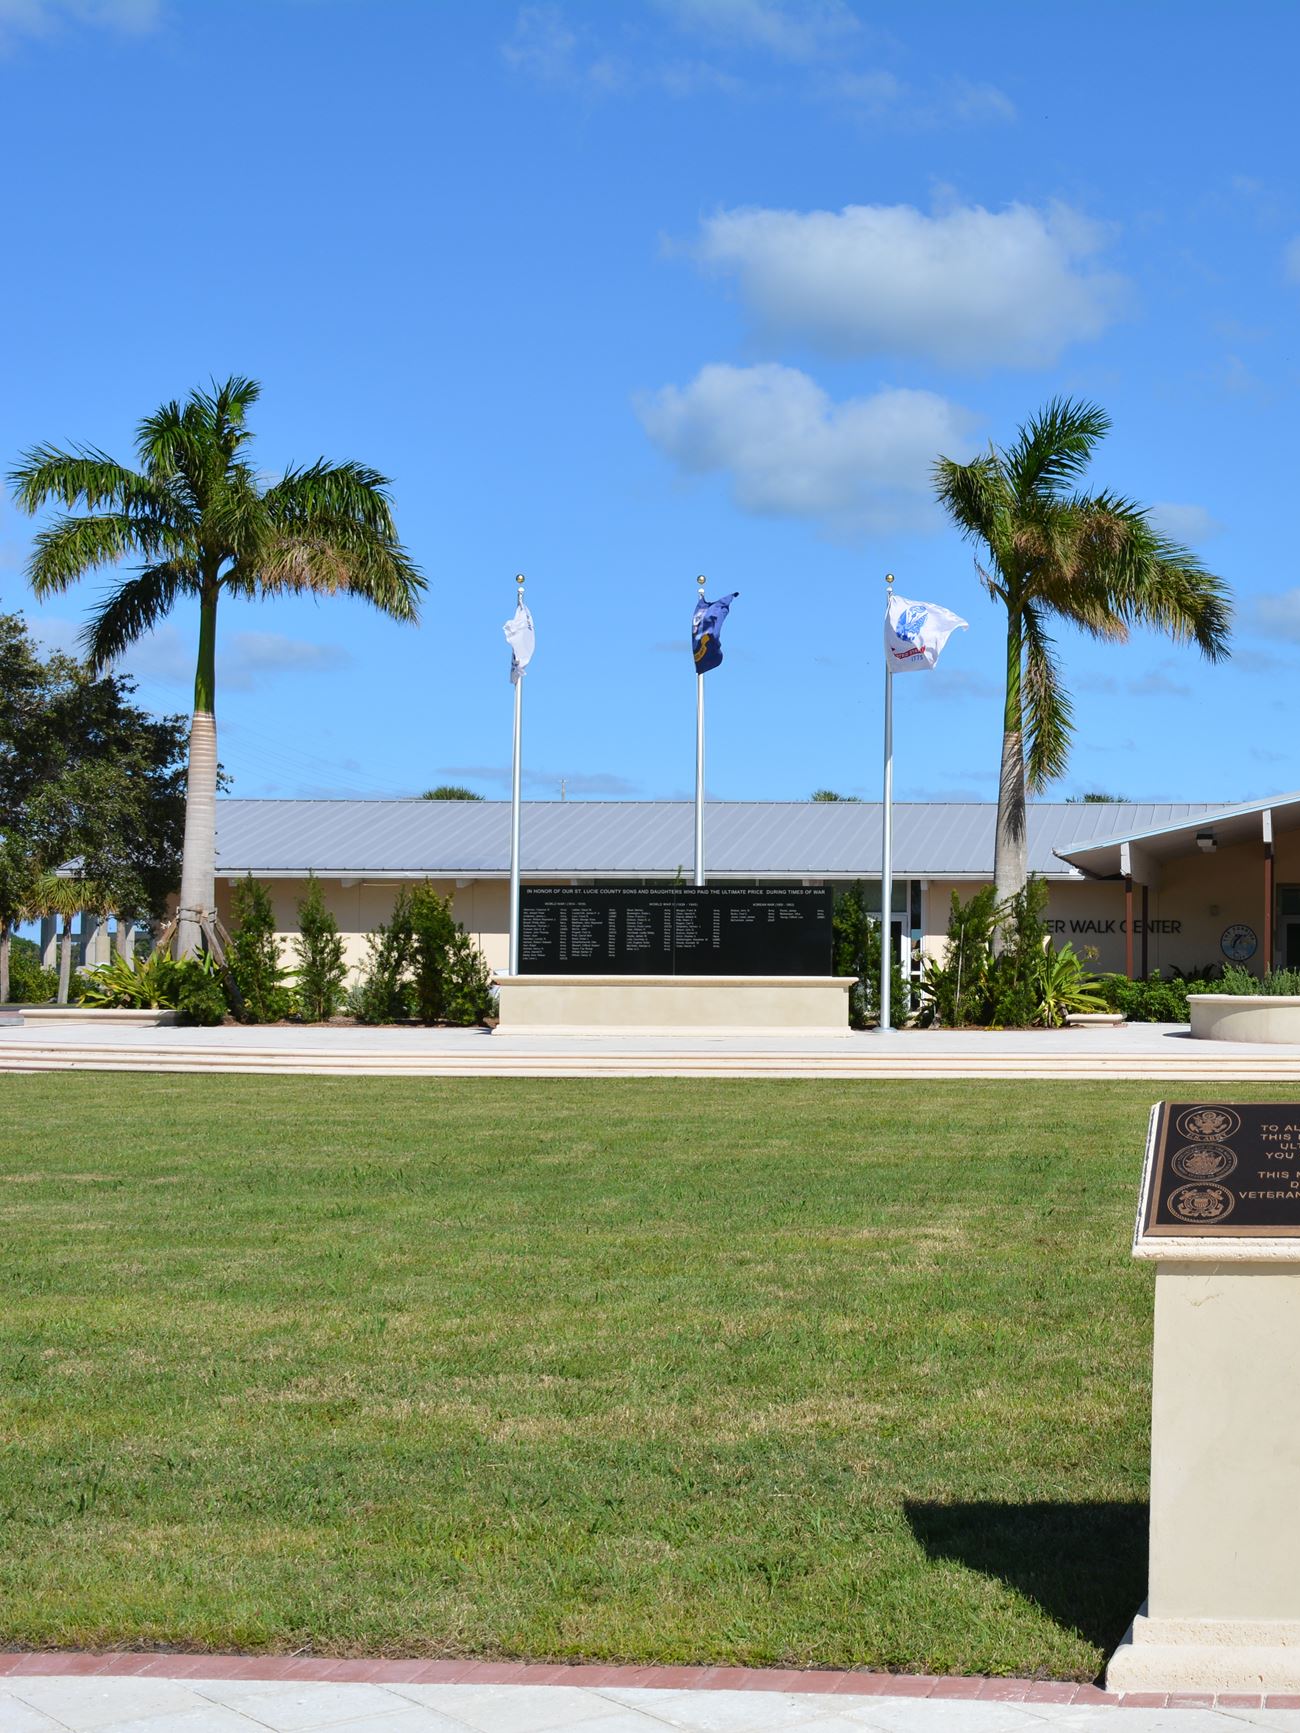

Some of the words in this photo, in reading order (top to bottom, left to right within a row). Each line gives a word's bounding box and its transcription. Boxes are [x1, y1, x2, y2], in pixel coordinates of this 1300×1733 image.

[1070, 920, 1116, 933] WALK
[1120, 920, 1181, 933] CENTER
[1261, 1124, 1278, 1132] TO
[1261, 1133, 1291, 1141] THIS
[1266, 1151, 1294, 1159] YOU
[1258, 1171, 1289, 1179] THIS
